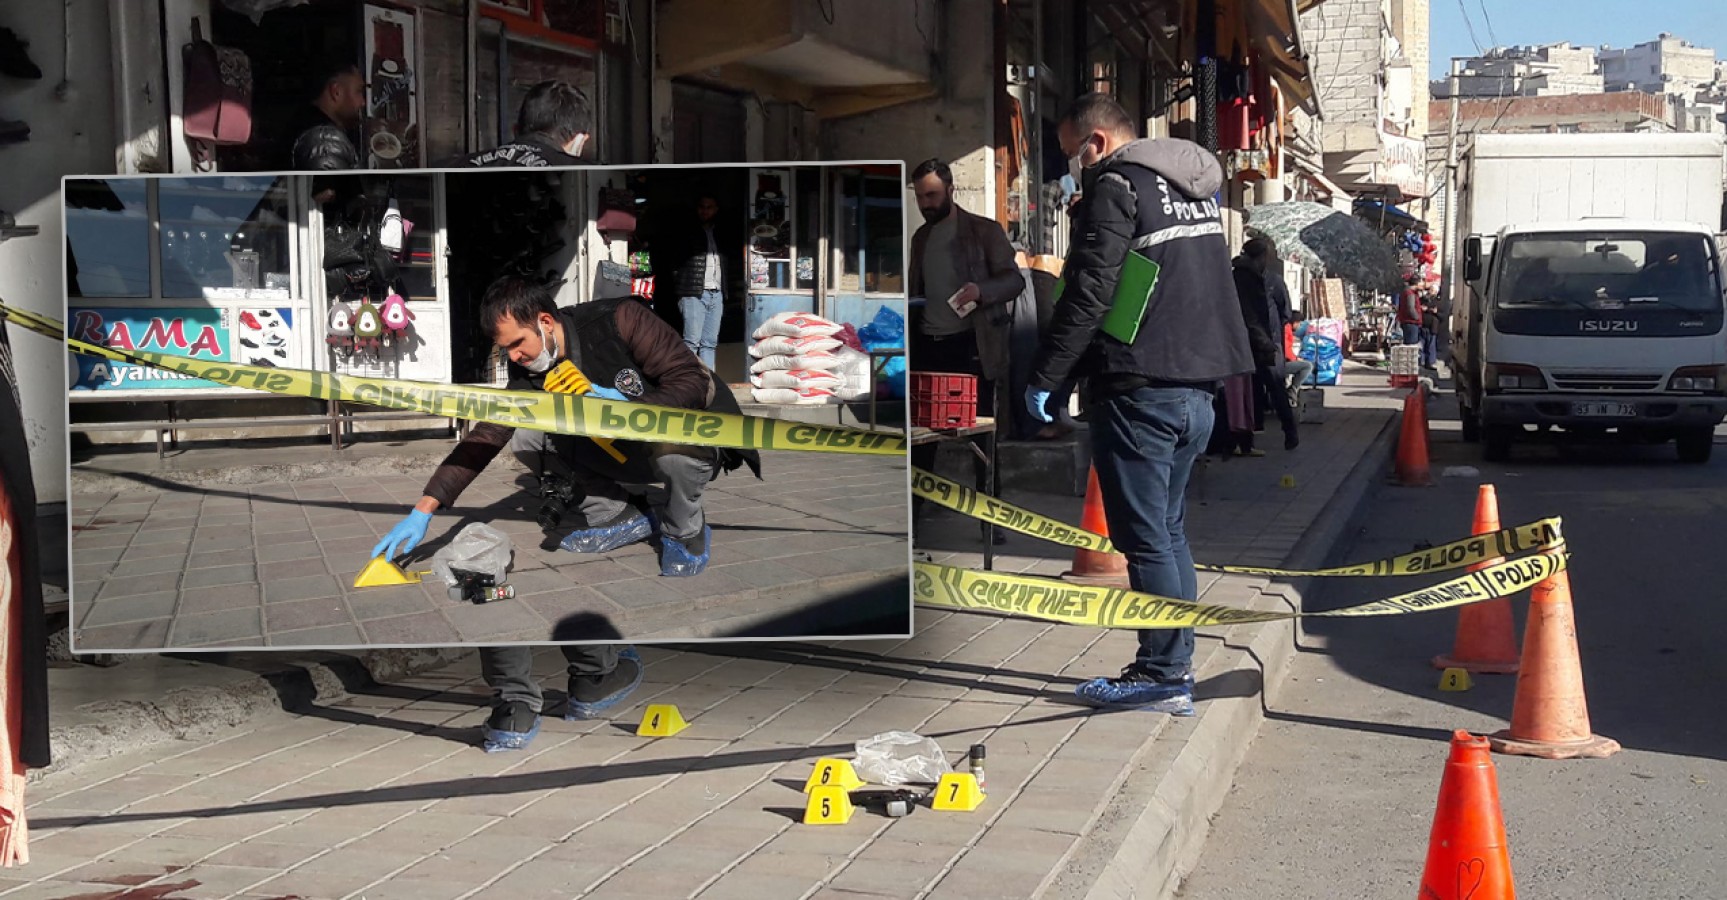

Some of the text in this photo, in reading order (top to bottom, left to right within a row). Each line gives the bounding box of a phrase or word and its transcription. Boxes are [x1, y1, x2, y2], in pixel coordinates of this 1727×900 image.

[72, 310, 222, 356] RAMA
[1579, 320, 1638, 331] ISUZU
[1494, 559, 1543, 590] POLİS
[1449, 674, 1458, 688] 3
[651, 713, 661, 731] 4
[821, 765, 832, 784] 6
[949, 783, 960, 802] 7
[820, 798, 831, 818] 5
